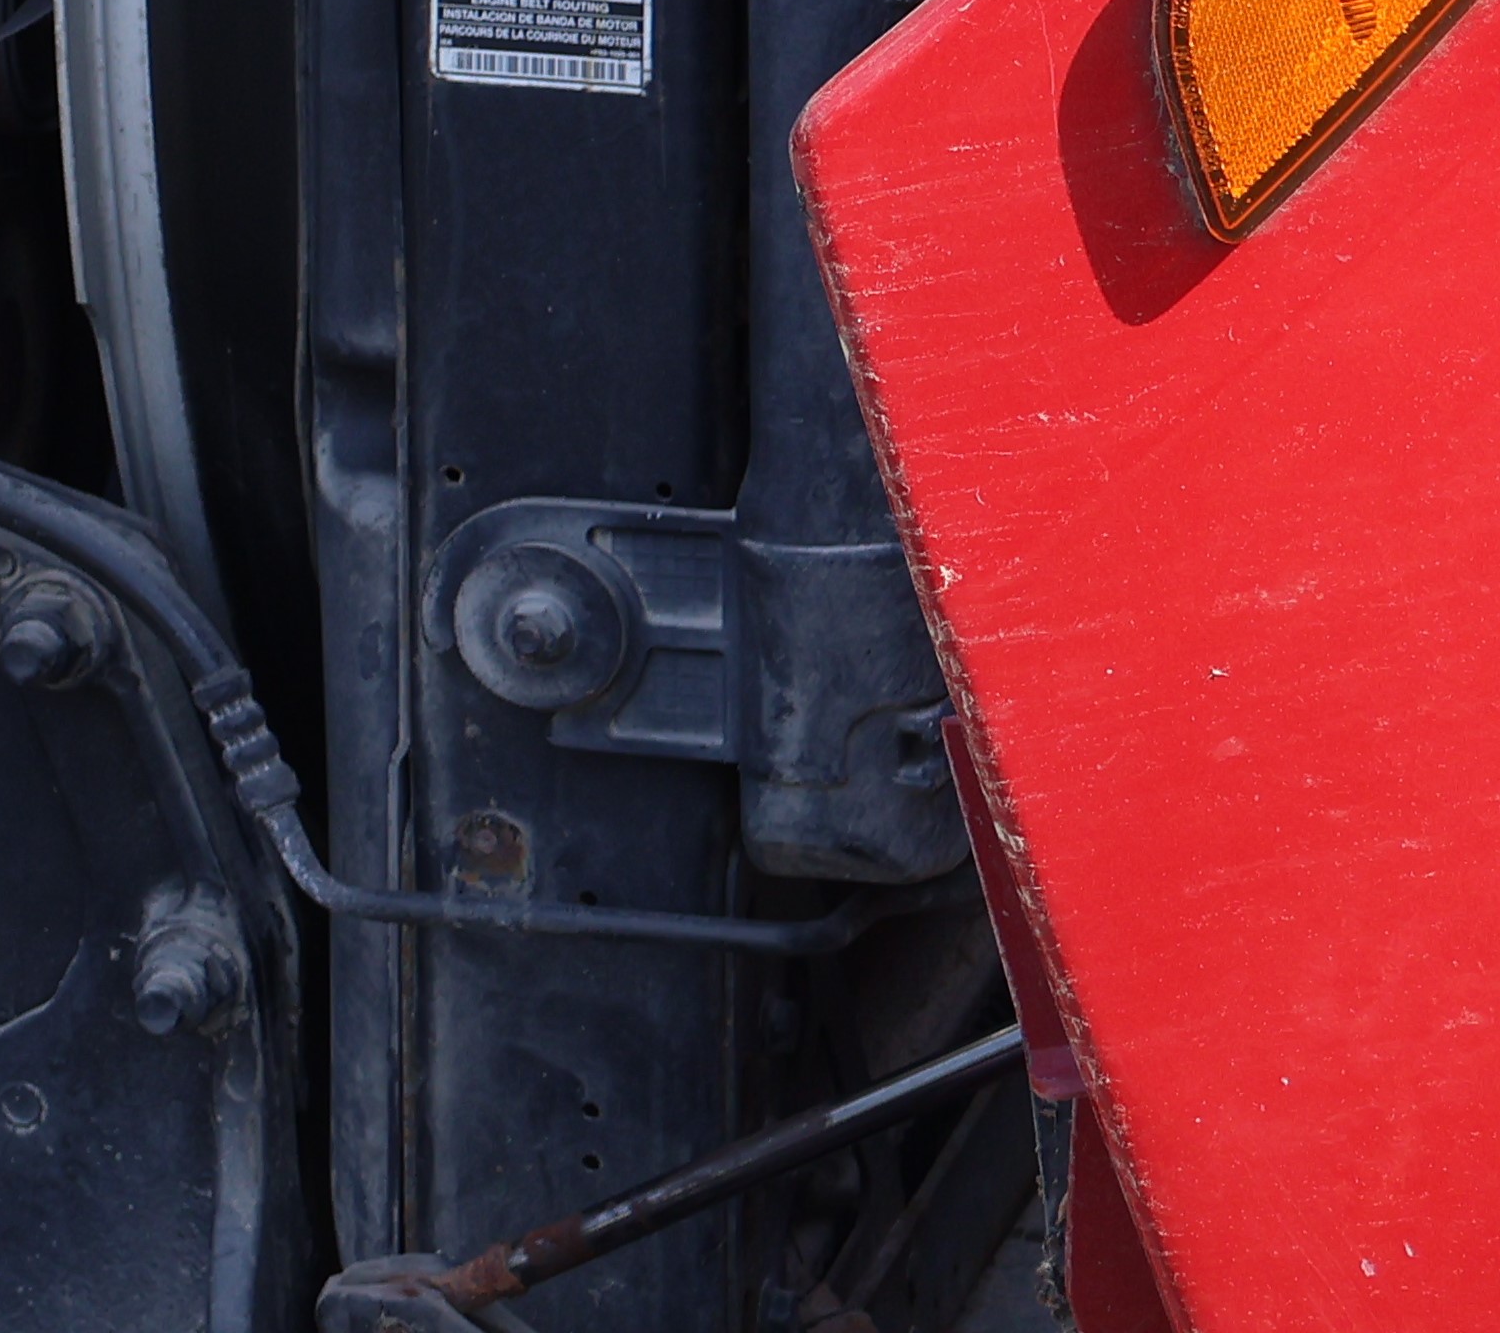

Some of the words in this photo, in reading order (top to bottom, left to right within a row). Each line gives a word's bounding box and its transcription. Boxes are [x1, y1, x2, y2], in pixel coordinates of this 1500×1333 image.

[553, 0, 609, 14] ROUTING
[518, 12, 534, 25] DE
[536, 14, 577, 27] BANDA
[578, 17, 593, 28] DE
[596, 18, 638, 32] MOTOR
[440, 24, 493, 38] PARCOURS
[495, 27, 510, 40] DE
[511, 29, 524, 40] LA
[526, 30, 579, 44] COURROIE
[581, 33, 596, 45] DU
[597, 35, 641, 47] MOTEUR
